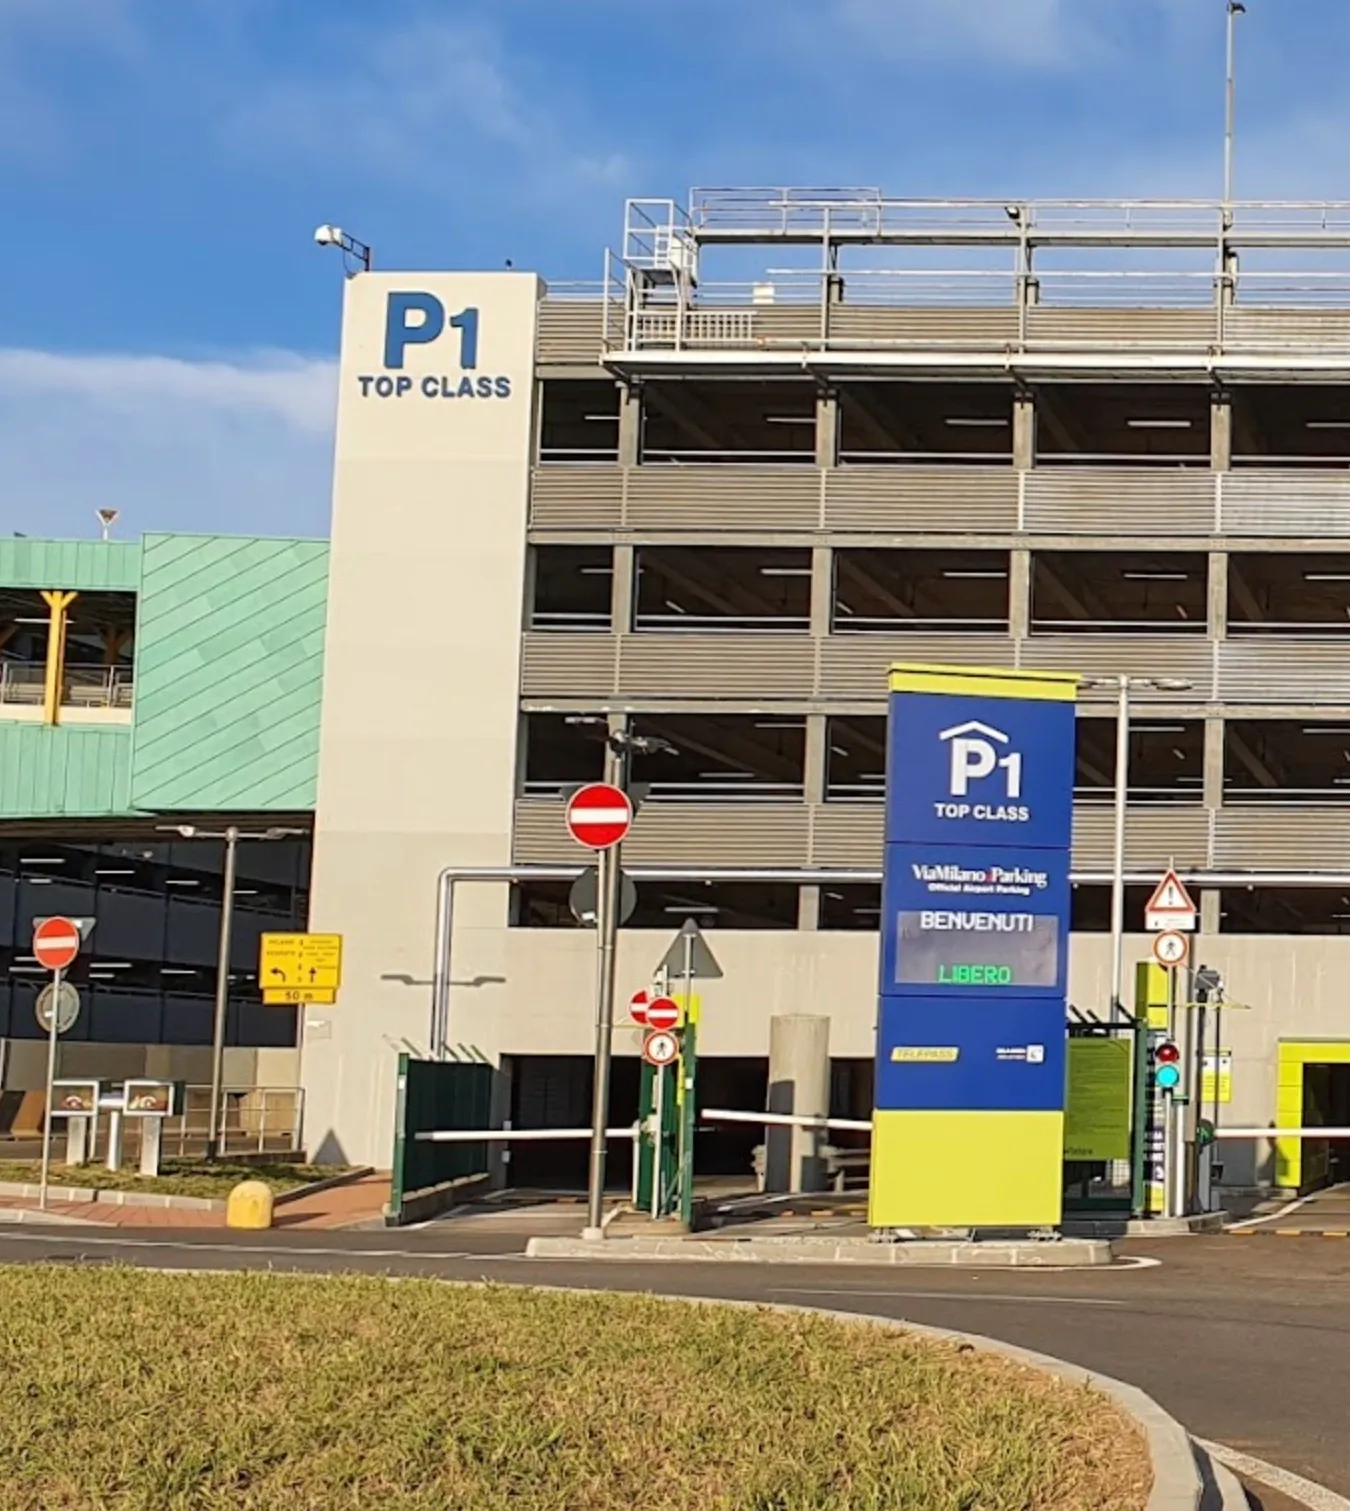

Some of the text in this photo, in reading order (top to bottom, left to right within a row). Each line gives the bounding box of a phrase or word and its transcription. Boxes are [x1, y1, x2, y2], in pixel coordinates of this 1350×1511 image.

[384, 291, 479, 369] P1
[358, 376, 511, 398] TOP CLASS
[951, 738, 1021, 798] P1
[934, 802, 1030, 822] TOP CLASS
[928, 883, 961, 892] Official
[920, 911, 1034, 932] BENVENUTI
[938, 965, 1012, 984] LIBERO
